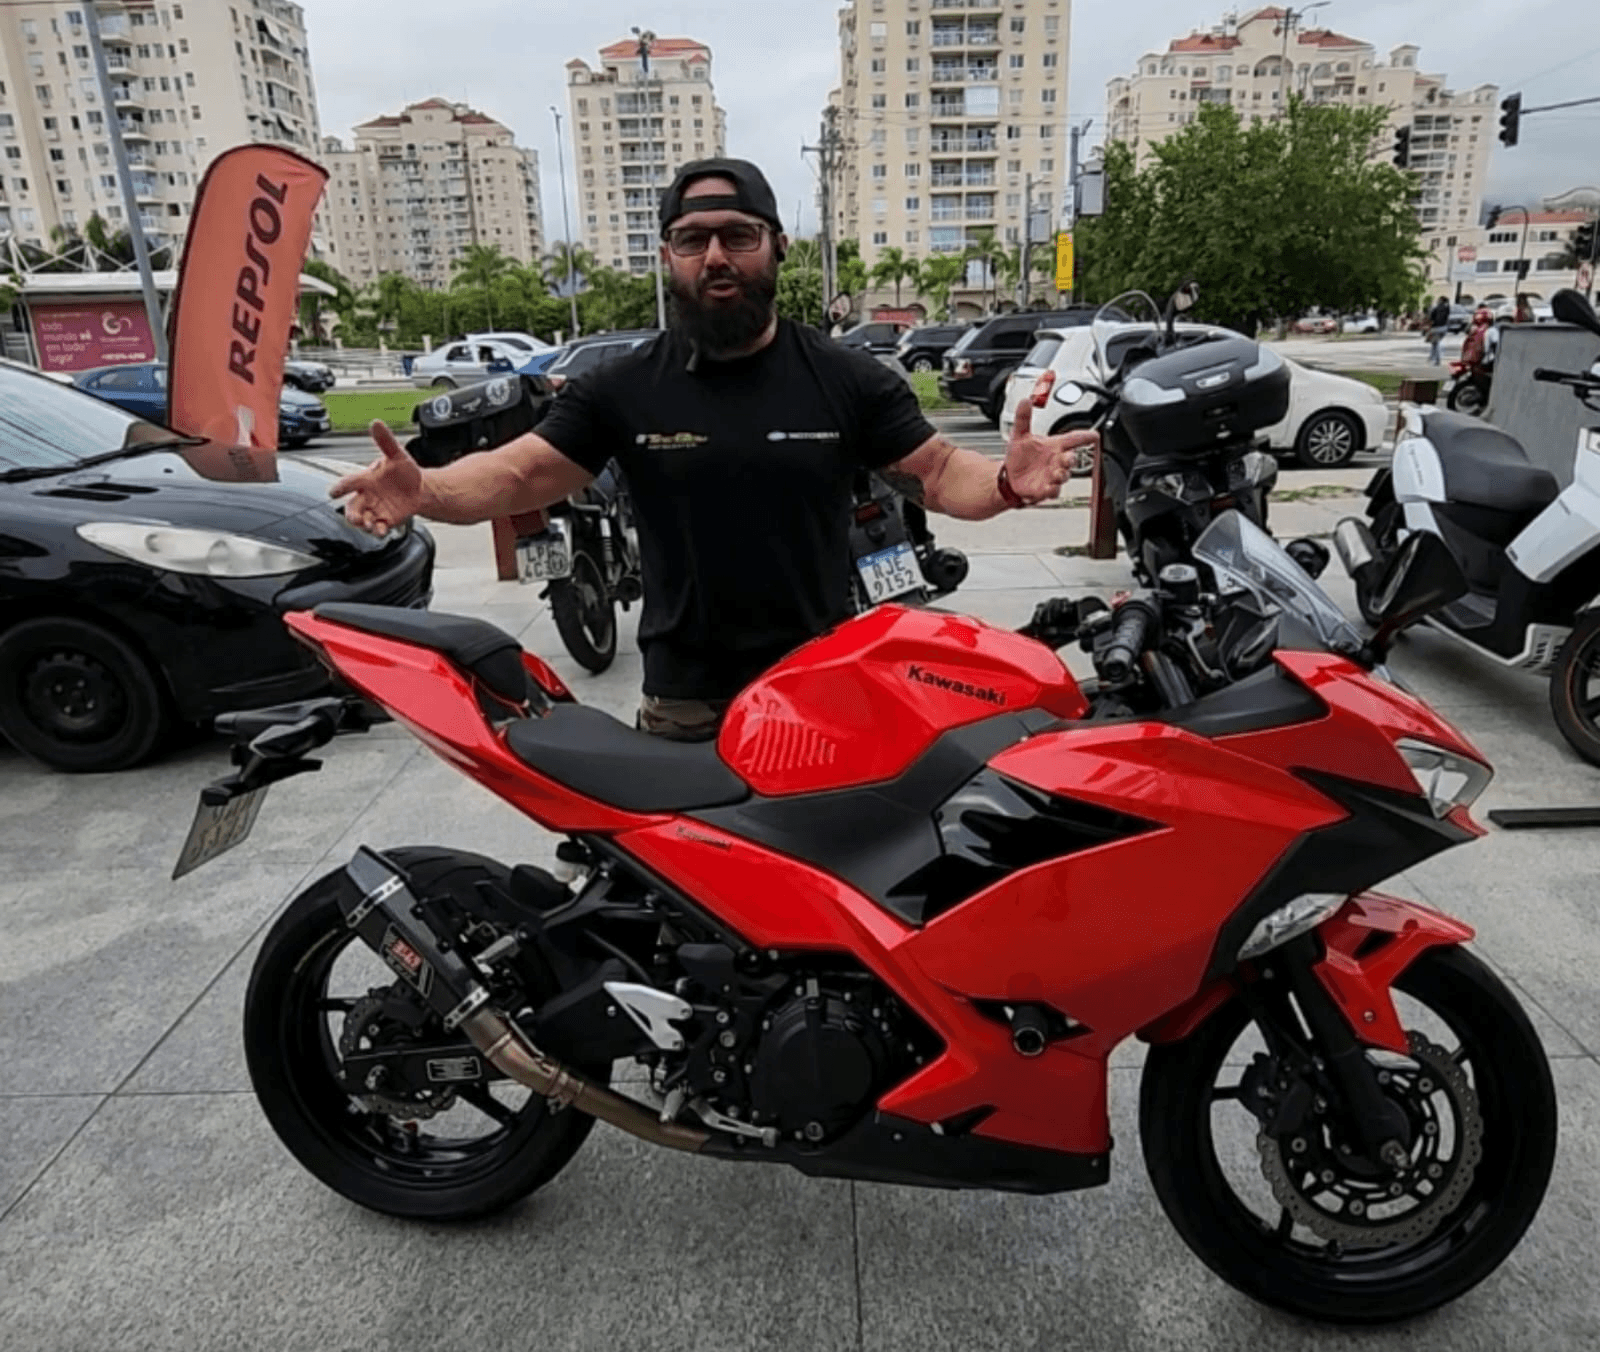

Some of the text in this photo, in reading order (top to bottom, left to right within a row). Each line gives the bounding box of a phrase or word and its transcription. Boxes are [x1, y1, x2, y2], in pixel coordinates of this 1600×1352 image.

[228, 172, 289, 385] REPSOL
[872, 556, 906, 580] RJE
[873, 569, 916, 597] 9152
[907, 664, 1006, 706] Kawasaki
